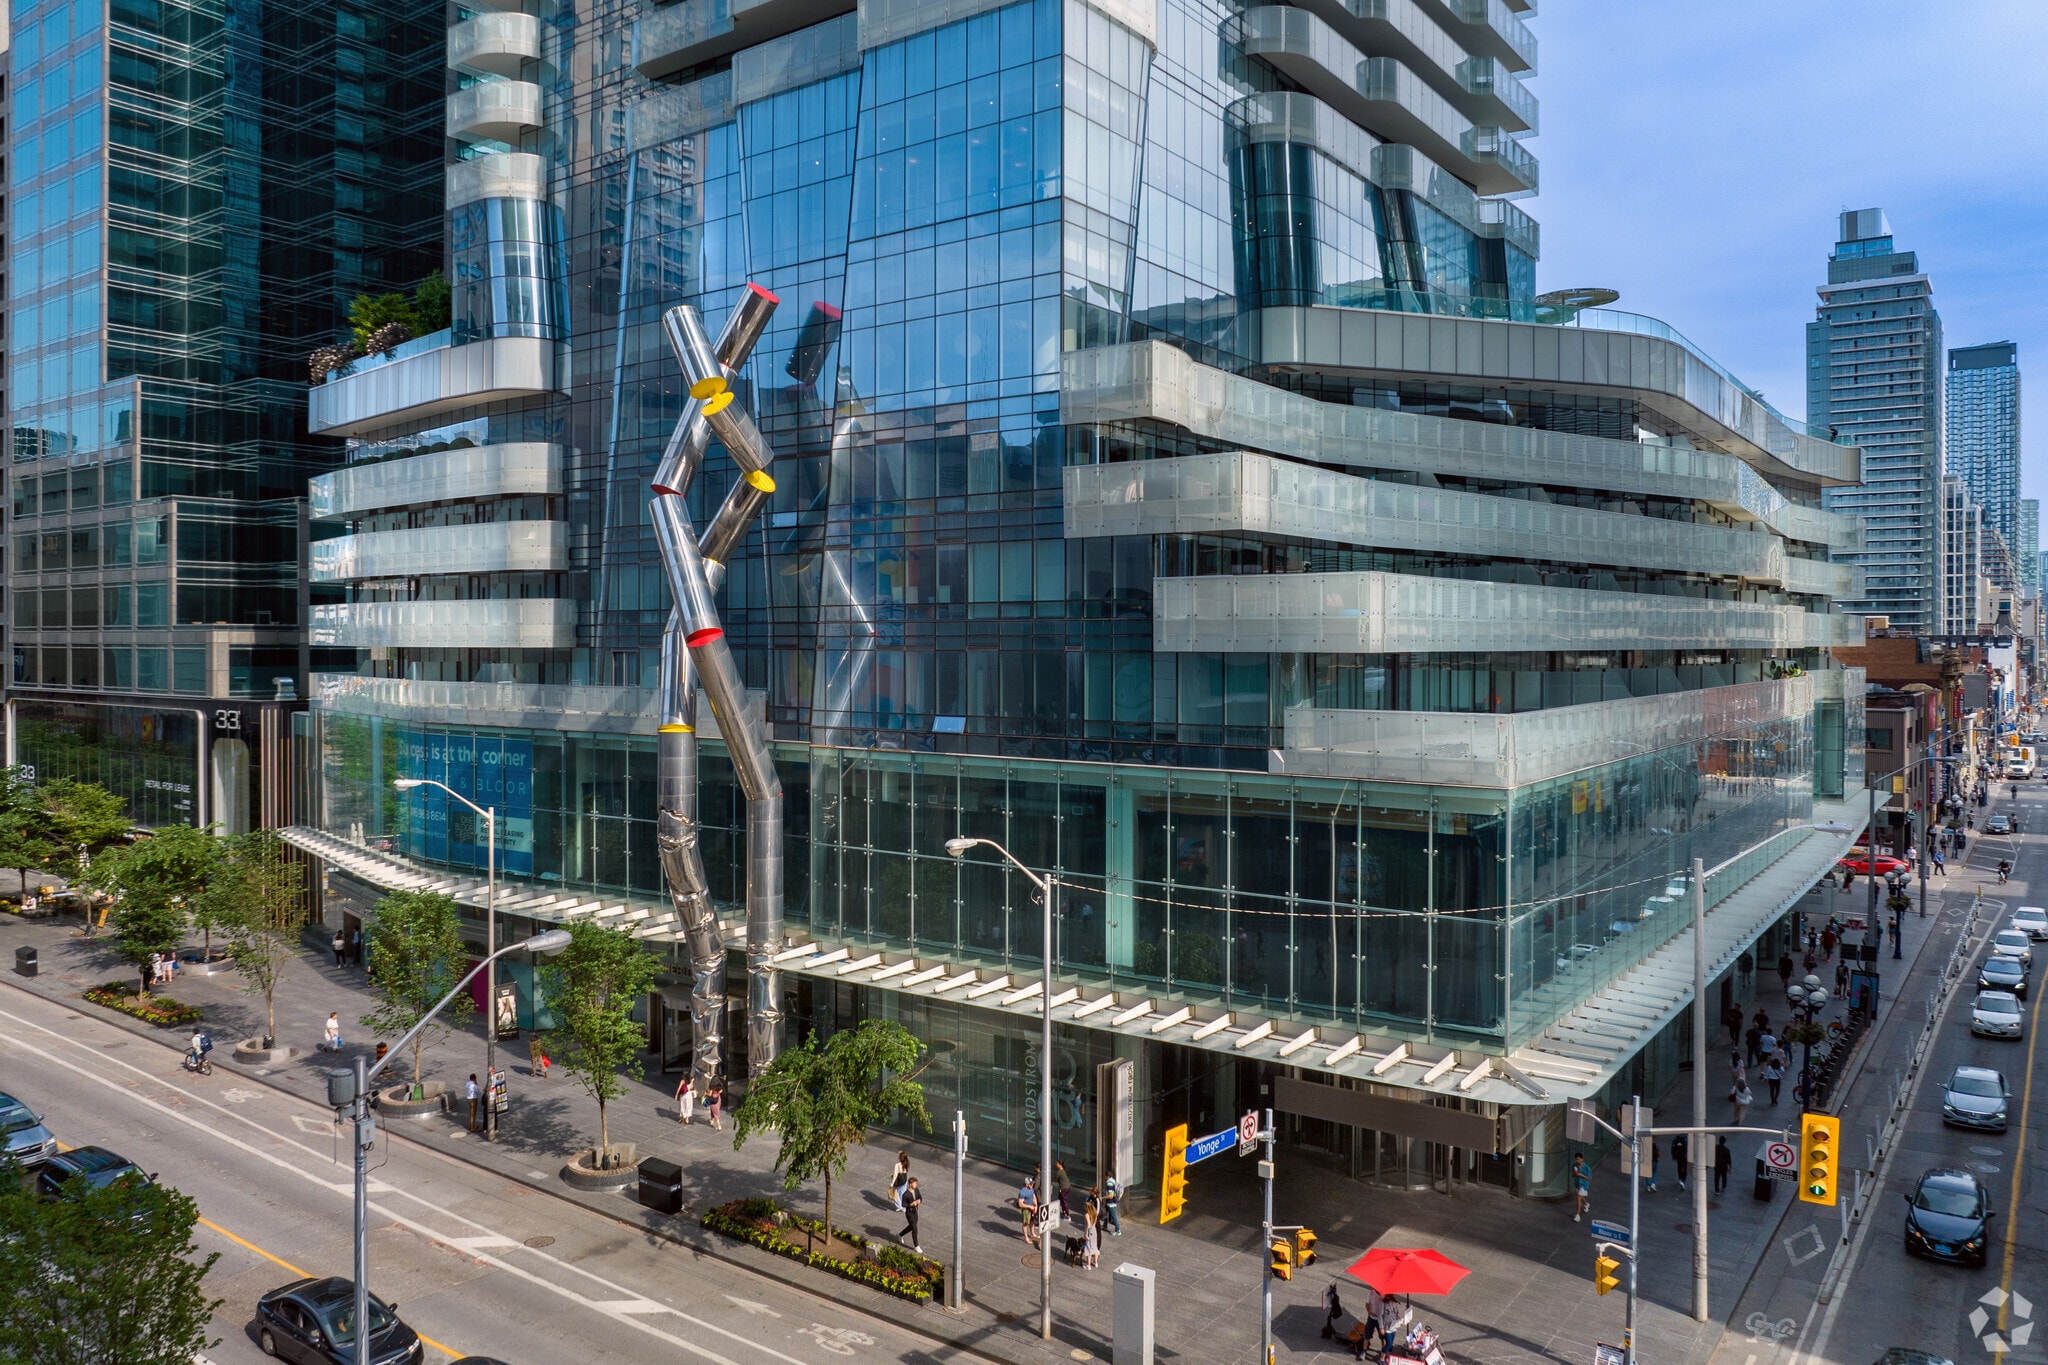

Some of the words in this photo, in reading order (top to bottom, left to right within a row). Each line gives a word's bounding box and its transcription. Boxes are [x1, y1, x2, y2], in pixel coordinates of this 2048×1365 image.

[215, 709, 240, 730] 33
[431, 743, 440, 760] is
[457, 745, 478, 763] the
[482, 750, 526, 766] corner
[460, 776, 467, 789] &
[477, 778, 526, 795] BLOOR
[1024, 1040, 1037, 1144] NORDSTROM
[1197, 1138, 1220, 1156] Yonge
